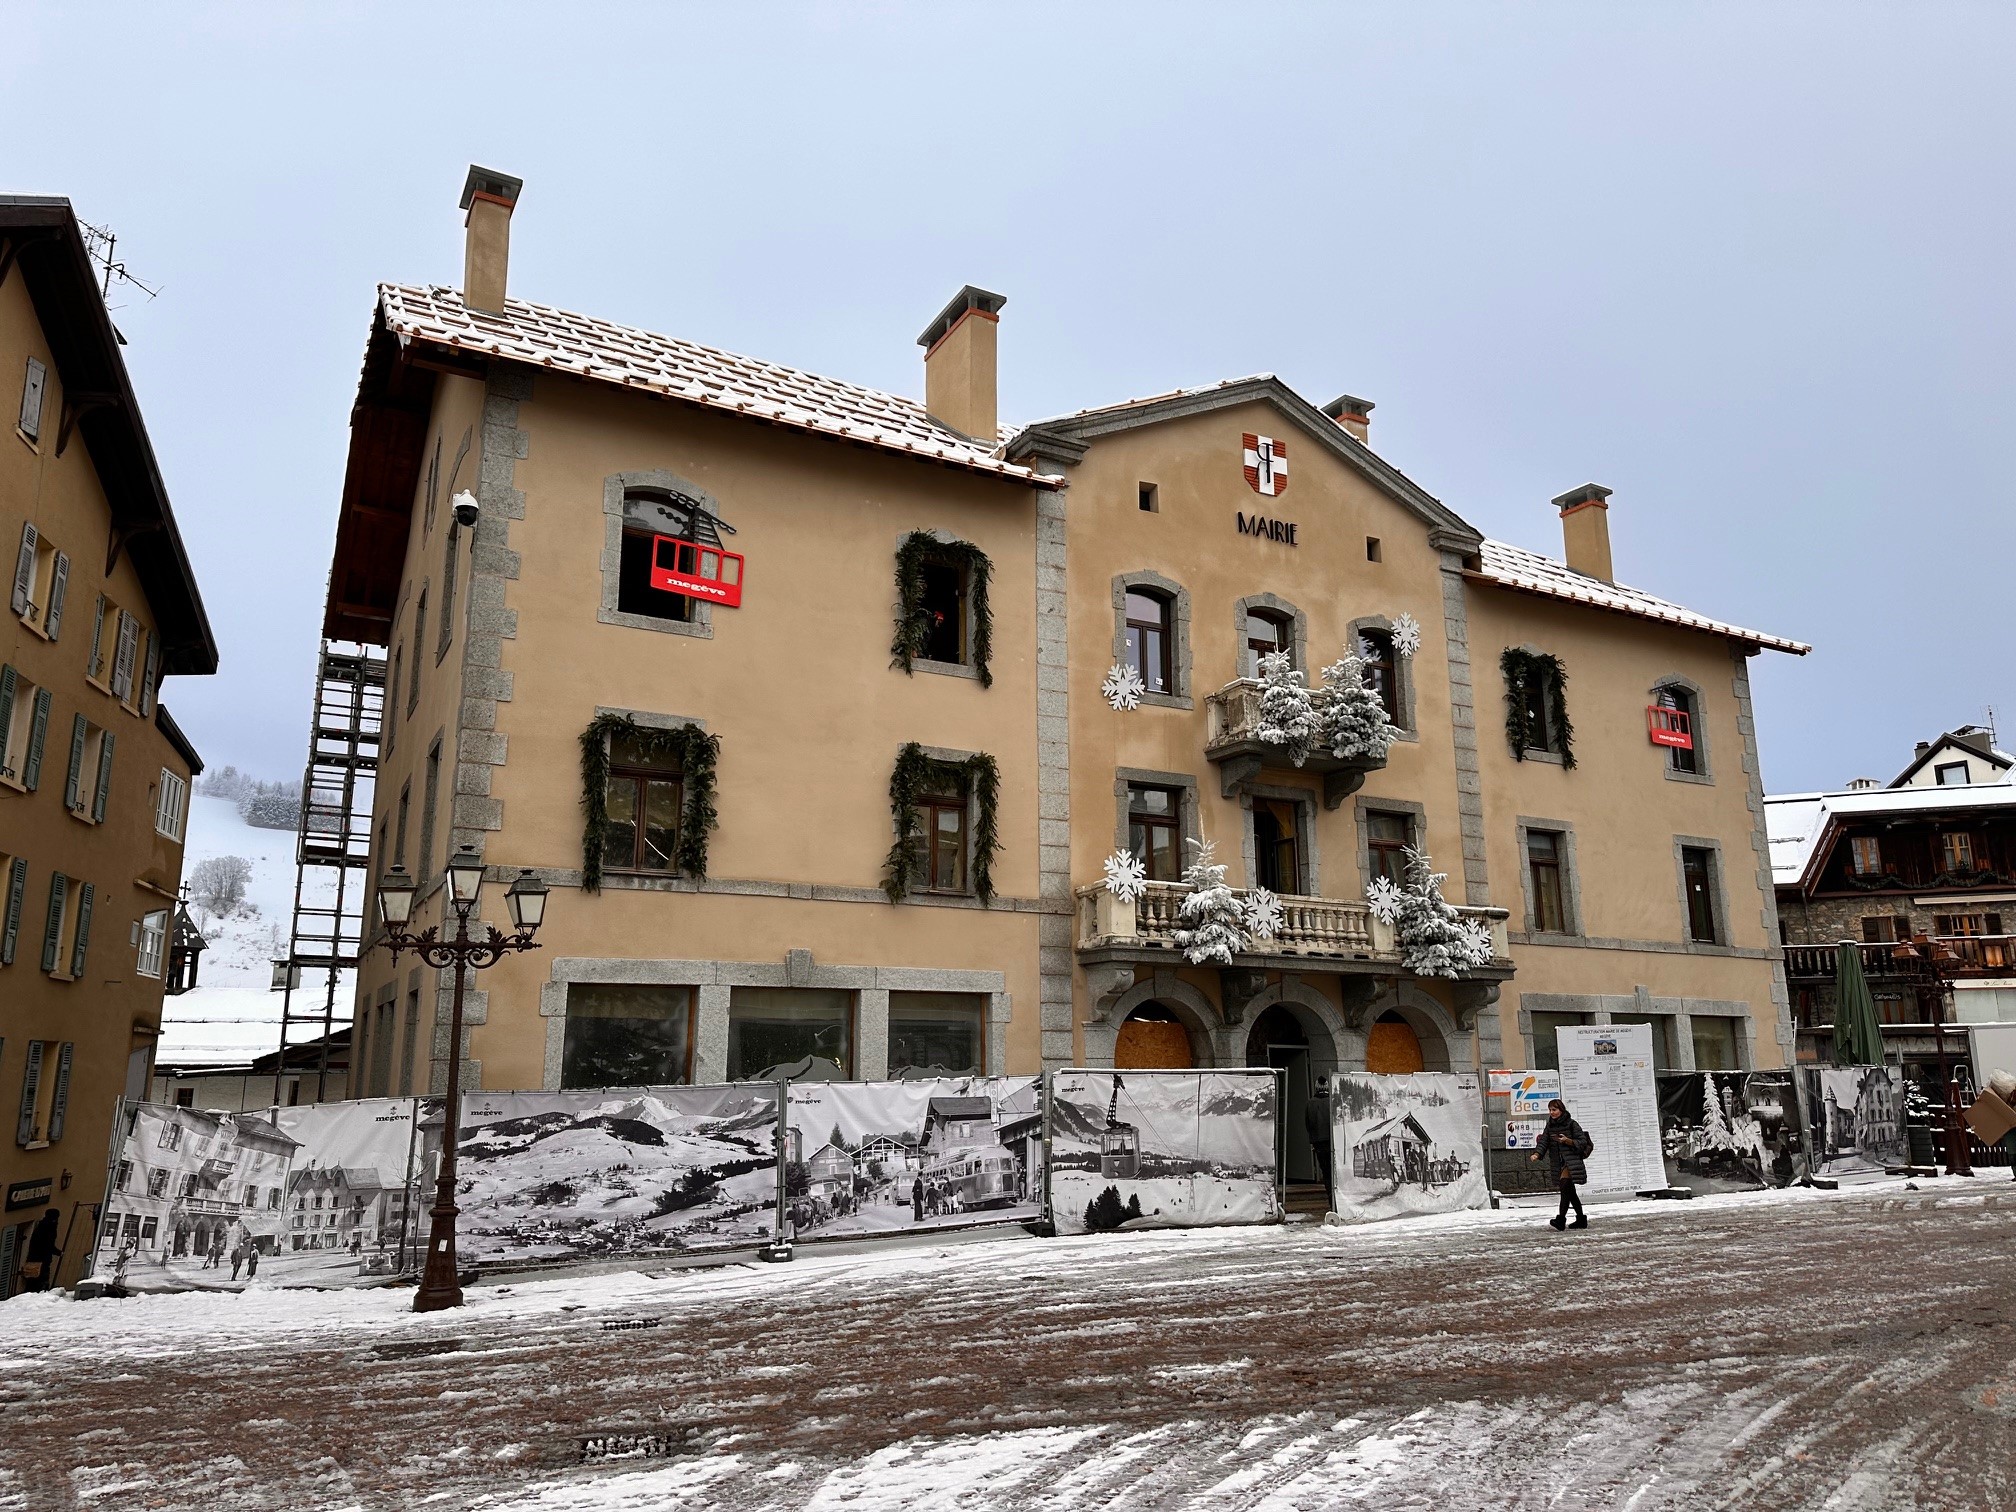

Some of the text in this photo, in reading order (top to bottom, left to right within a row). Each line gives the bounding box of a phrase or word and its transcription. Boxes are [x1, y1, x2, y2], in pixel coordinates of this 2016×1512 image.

[1237, 511, 1299, 547] MAIRIE
[666, 578, 726, 596] megève
[1514, 1100, 1540, 1112] Bee
